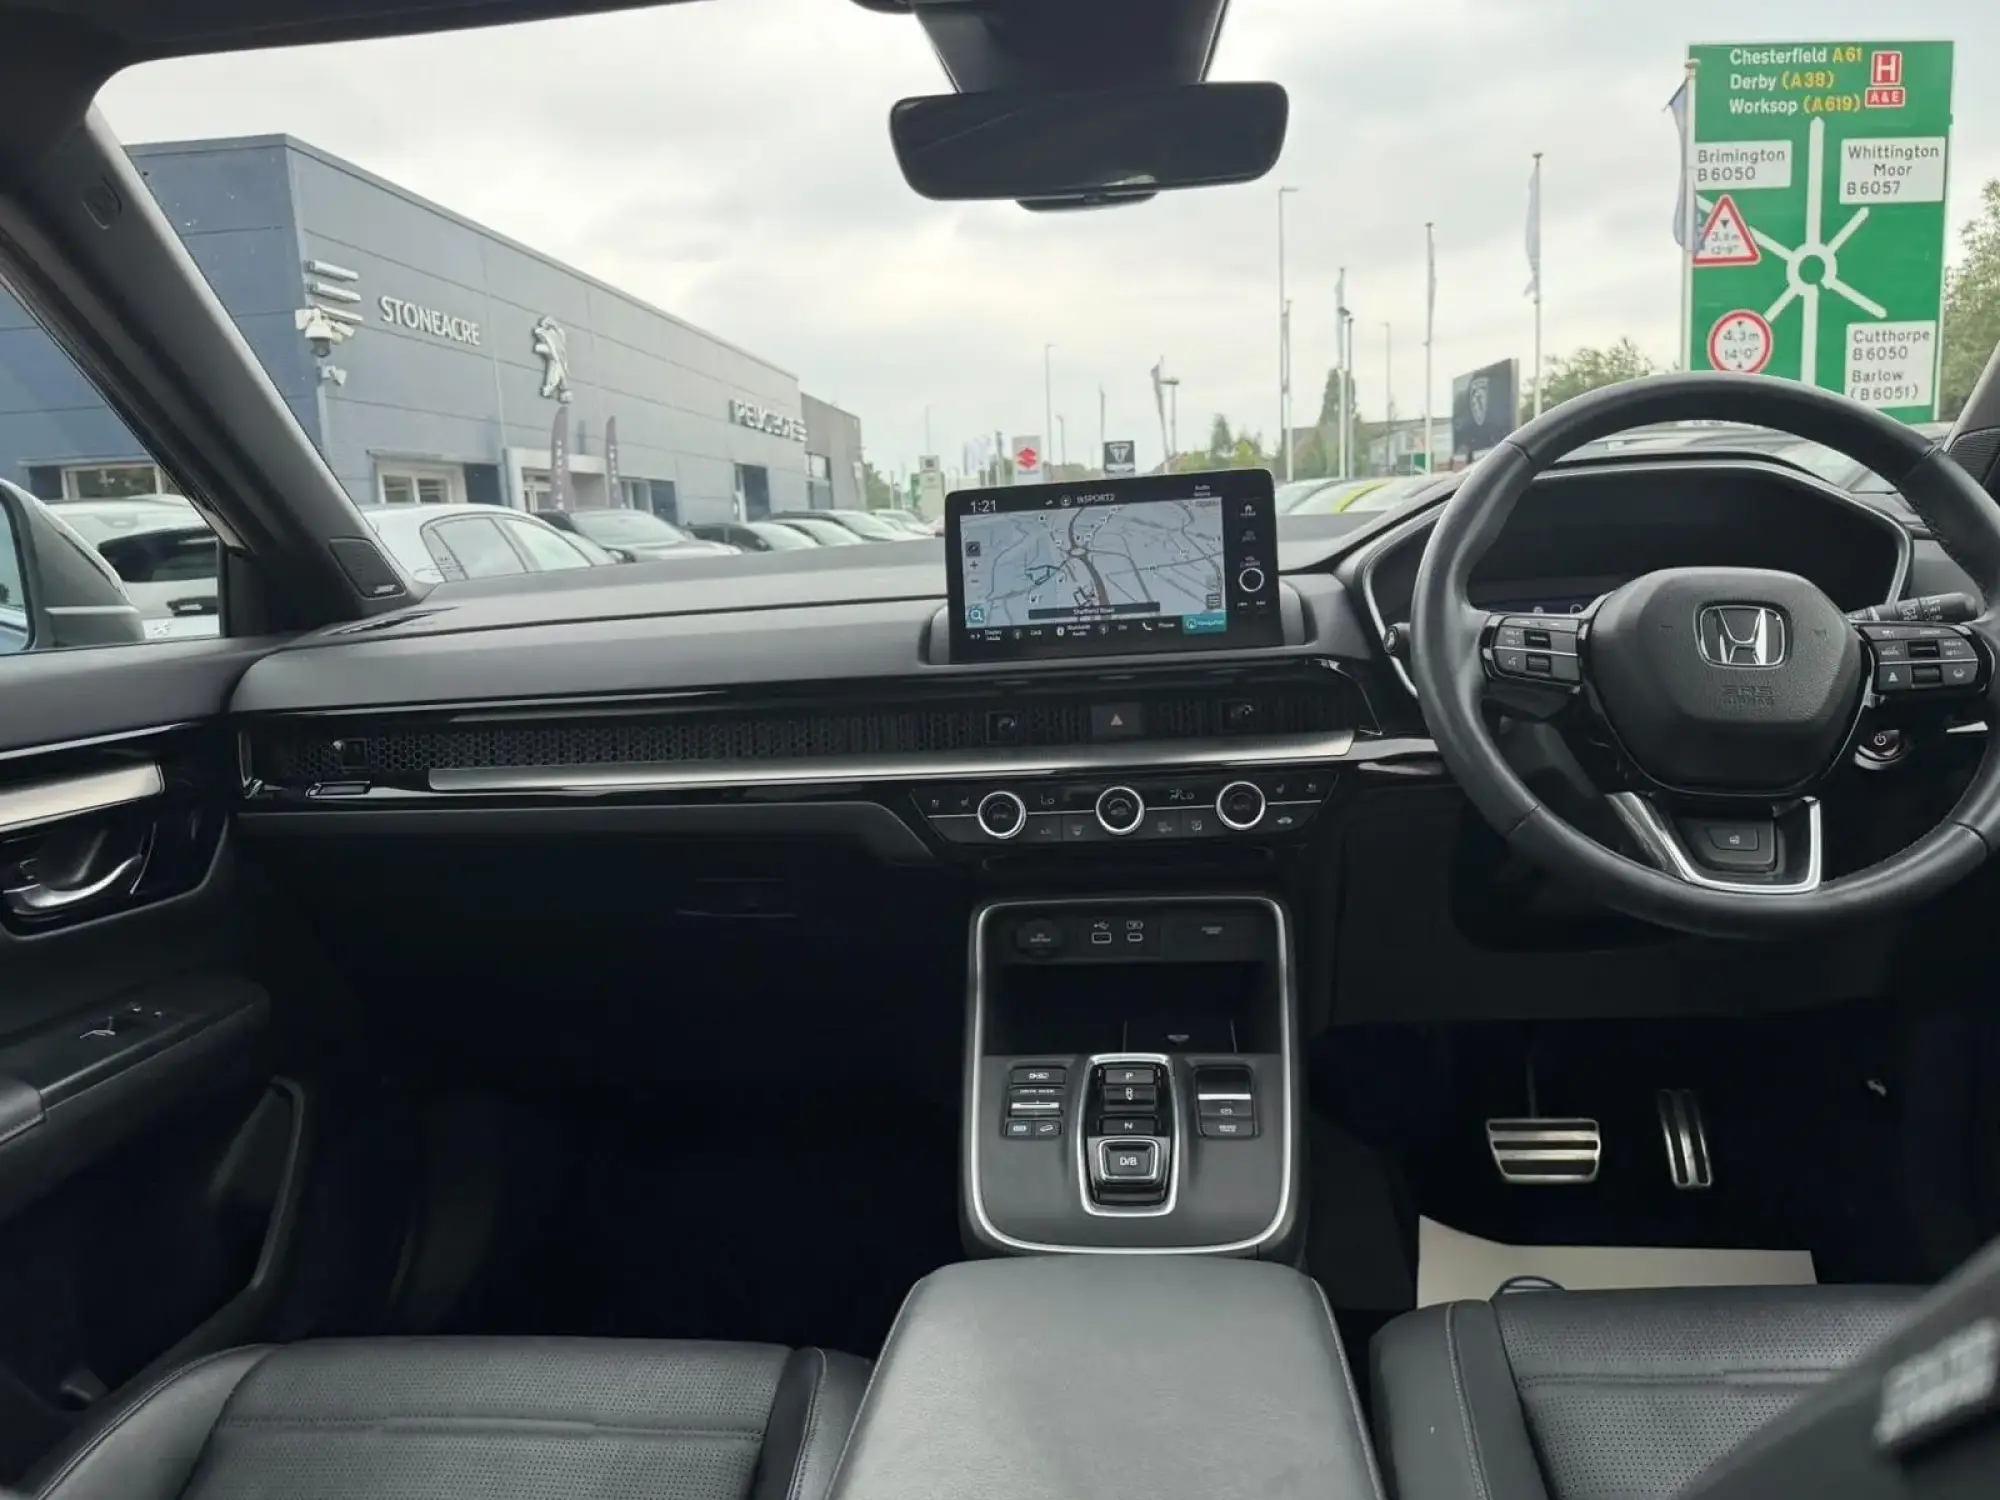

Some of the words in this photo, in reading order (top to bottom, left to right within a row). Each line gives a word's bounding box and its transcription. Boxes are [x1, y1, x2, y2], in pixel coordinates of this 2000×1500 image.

[1729, 47, 1827, 65] Chesterfield
[1832, 46, 1862, 63] A61
[1876, 54, 1897, 82] H
[1730, 73, 1776, 91] Derby
[1781, 70, 1835, 90] (A38)
[1729, 97, 1798, 115] Worksop
[1803, 94, 1861, 113] (A619)
[1869, 90, 1900, 104] A&E
[1697, 149, 1786, 165] Brimington
[1848, 145, 1940, 161] Whittington
[1873, 163, 1912, 177] Moor
[380, 295, 480, 346] STONEACRE
[1853, 329, 1930, 345] Cutthorpe
[1852, 369, 1904, 383] Barlow
[970, 499, 996, 513] 1:21
